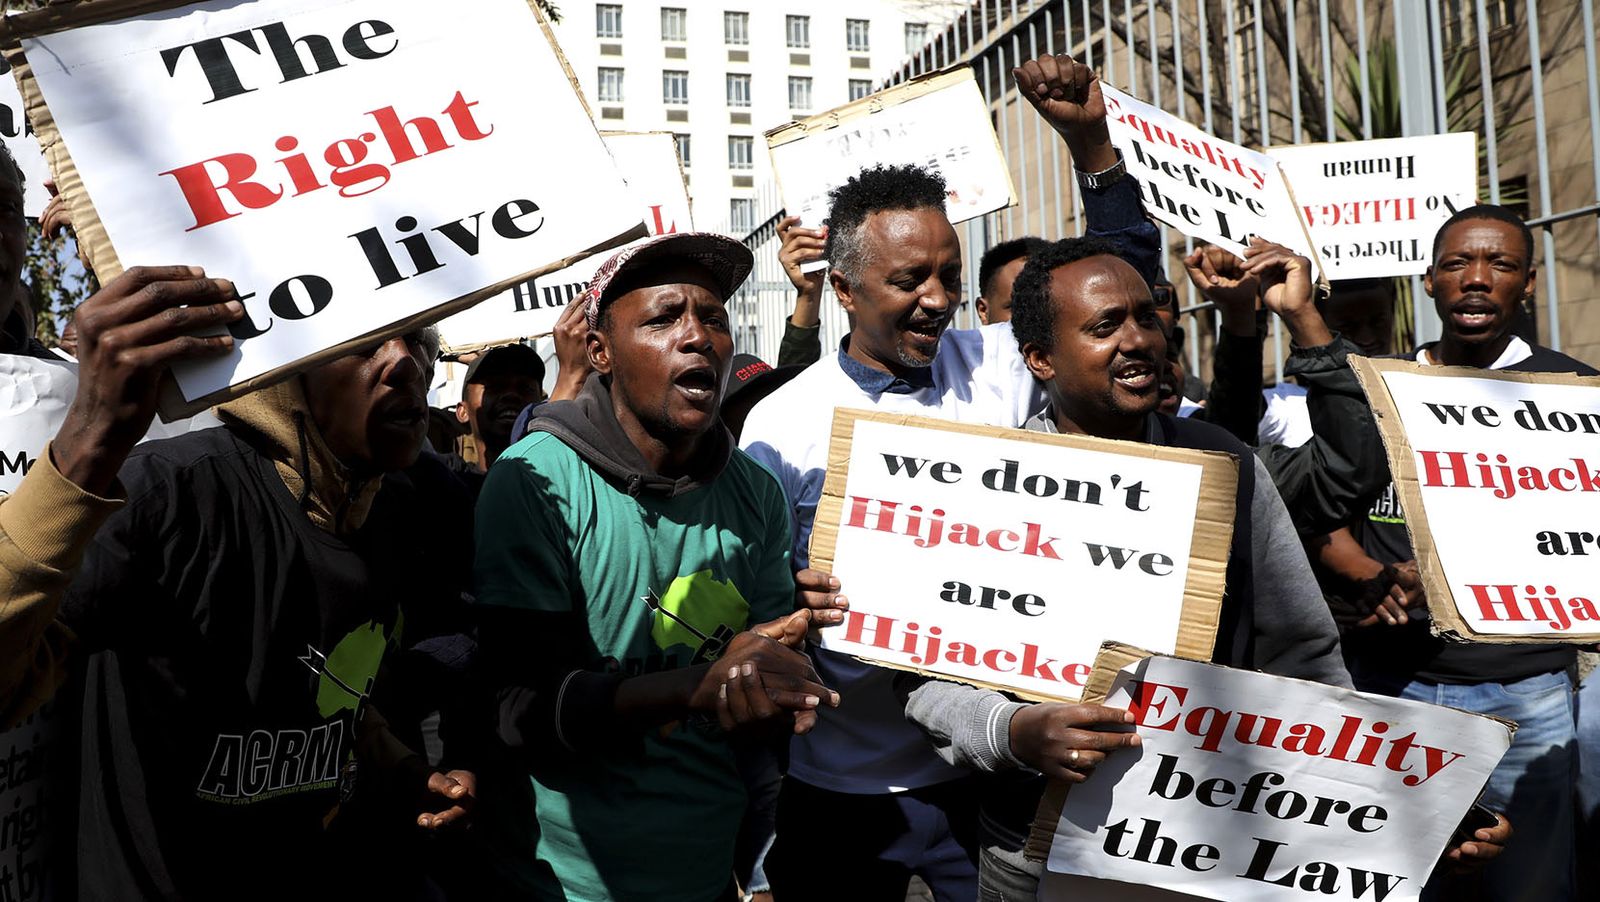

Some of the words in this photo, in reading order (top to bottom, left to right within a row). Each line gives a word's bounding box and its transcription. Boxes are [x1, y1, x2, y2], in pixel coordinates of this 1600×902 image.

[160, 19, 399, 105] The
[158, 90, 494, 232] Right
[1103, 97, 1266, 190] Equality
[1323, 155, 1416, 180] Human
[1131, 139, 1267, 218] before
[1138, 178, 1202, 226] the
[1426, 194, 1462, 217] No
[347, 198, 544, 291] live
[1321, 244, 1341, 266] is
[1349, 239, 1425, 262] There
[225, 274, 334, 340] to
[1422, 402, 1501, 428] we
[880, 452, 963, 484] we
[981, 459, 1150, 512] don't
[1416, 450, 1600, 499] Hijack
[843, 495, 1064, 561] Hijack
[1082, 541, 1174, 576] we
[1535, 530, 1600, 556] ar
[939, 579, 1046, 617] are
[1464, 584, 1600, 630] Hija
[839, 610, 1092, 687] Hijacke
[197, 719, 343, 797] ACRM
[1129, 679, 1466, 786] Equality
[1148, 753, 1388, 833] before
[1101, 817, 1220, 872] the
[1235, 836, 1408, 902] Law
